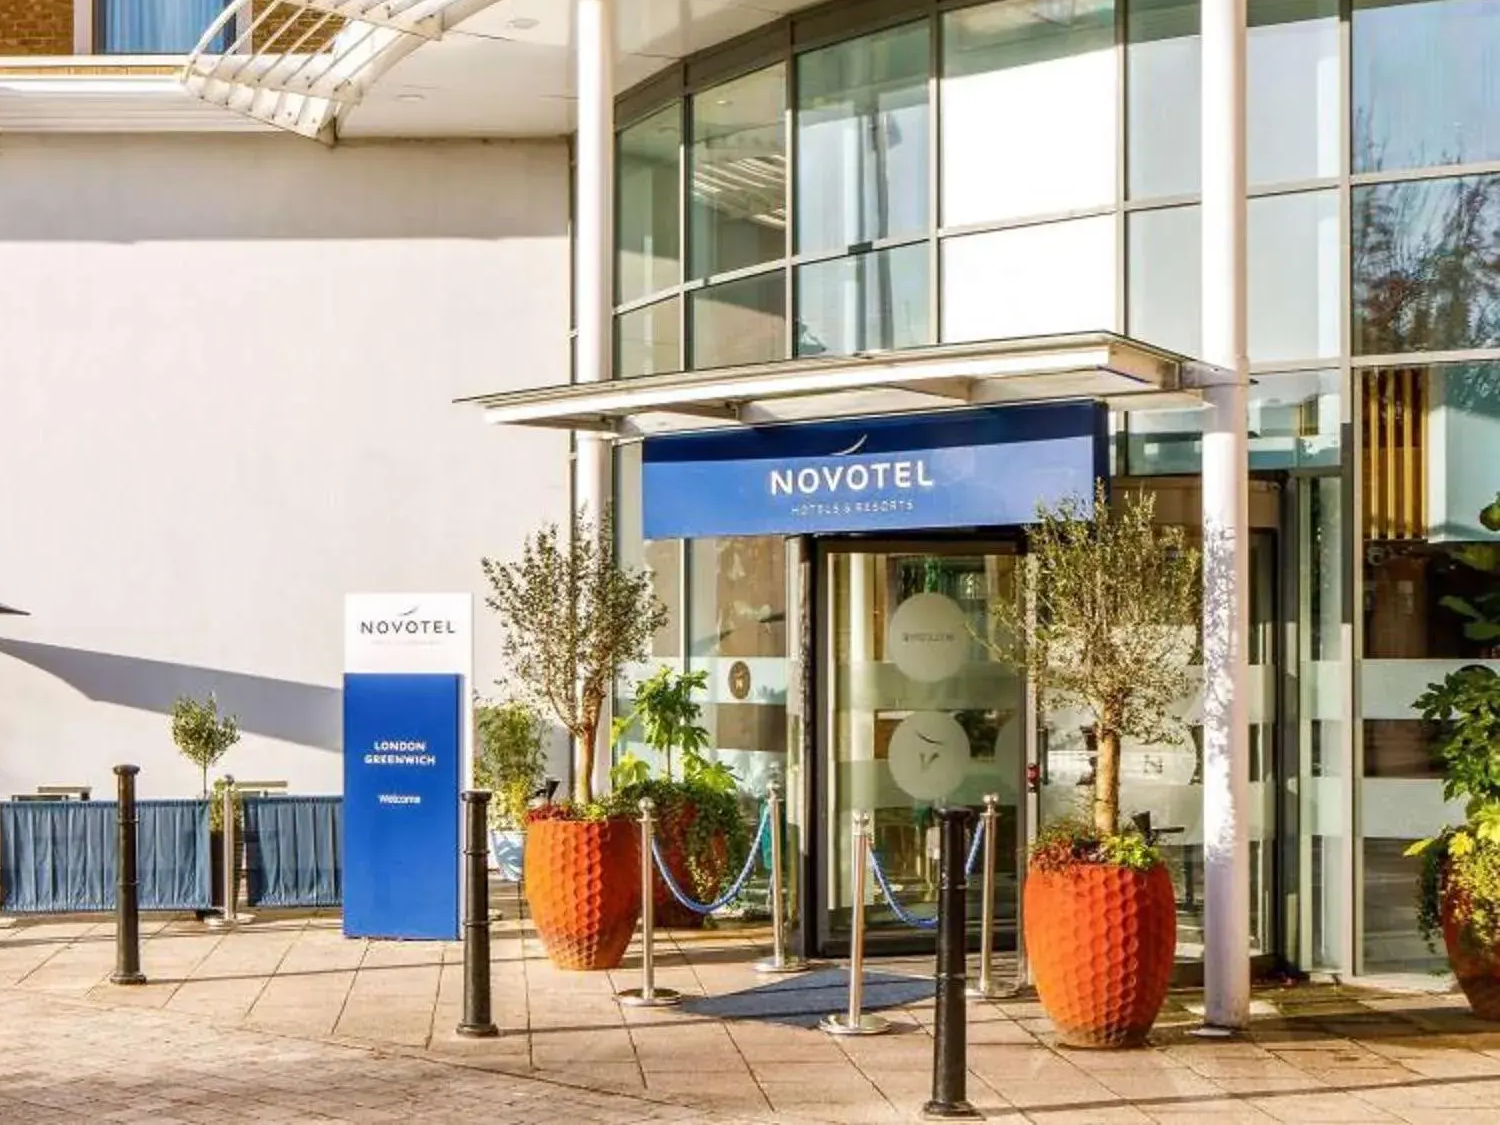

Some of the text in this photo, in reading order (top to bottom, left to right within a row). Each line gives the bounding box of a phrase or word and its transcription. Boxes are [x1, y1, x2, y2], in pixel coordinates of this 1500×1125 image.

[769, 460, 935, 496] NOVOTEL
[790, 501, 838, 516] HOTELS
[855, 498, 914, 513] RESORTS
[360, 620, 456, 635] NOVOTEL
[373, 741, 427, 752] LONDON
[363, 754, 437, 766] GREENWICH
[377, 793, 422, 804] Welcome
